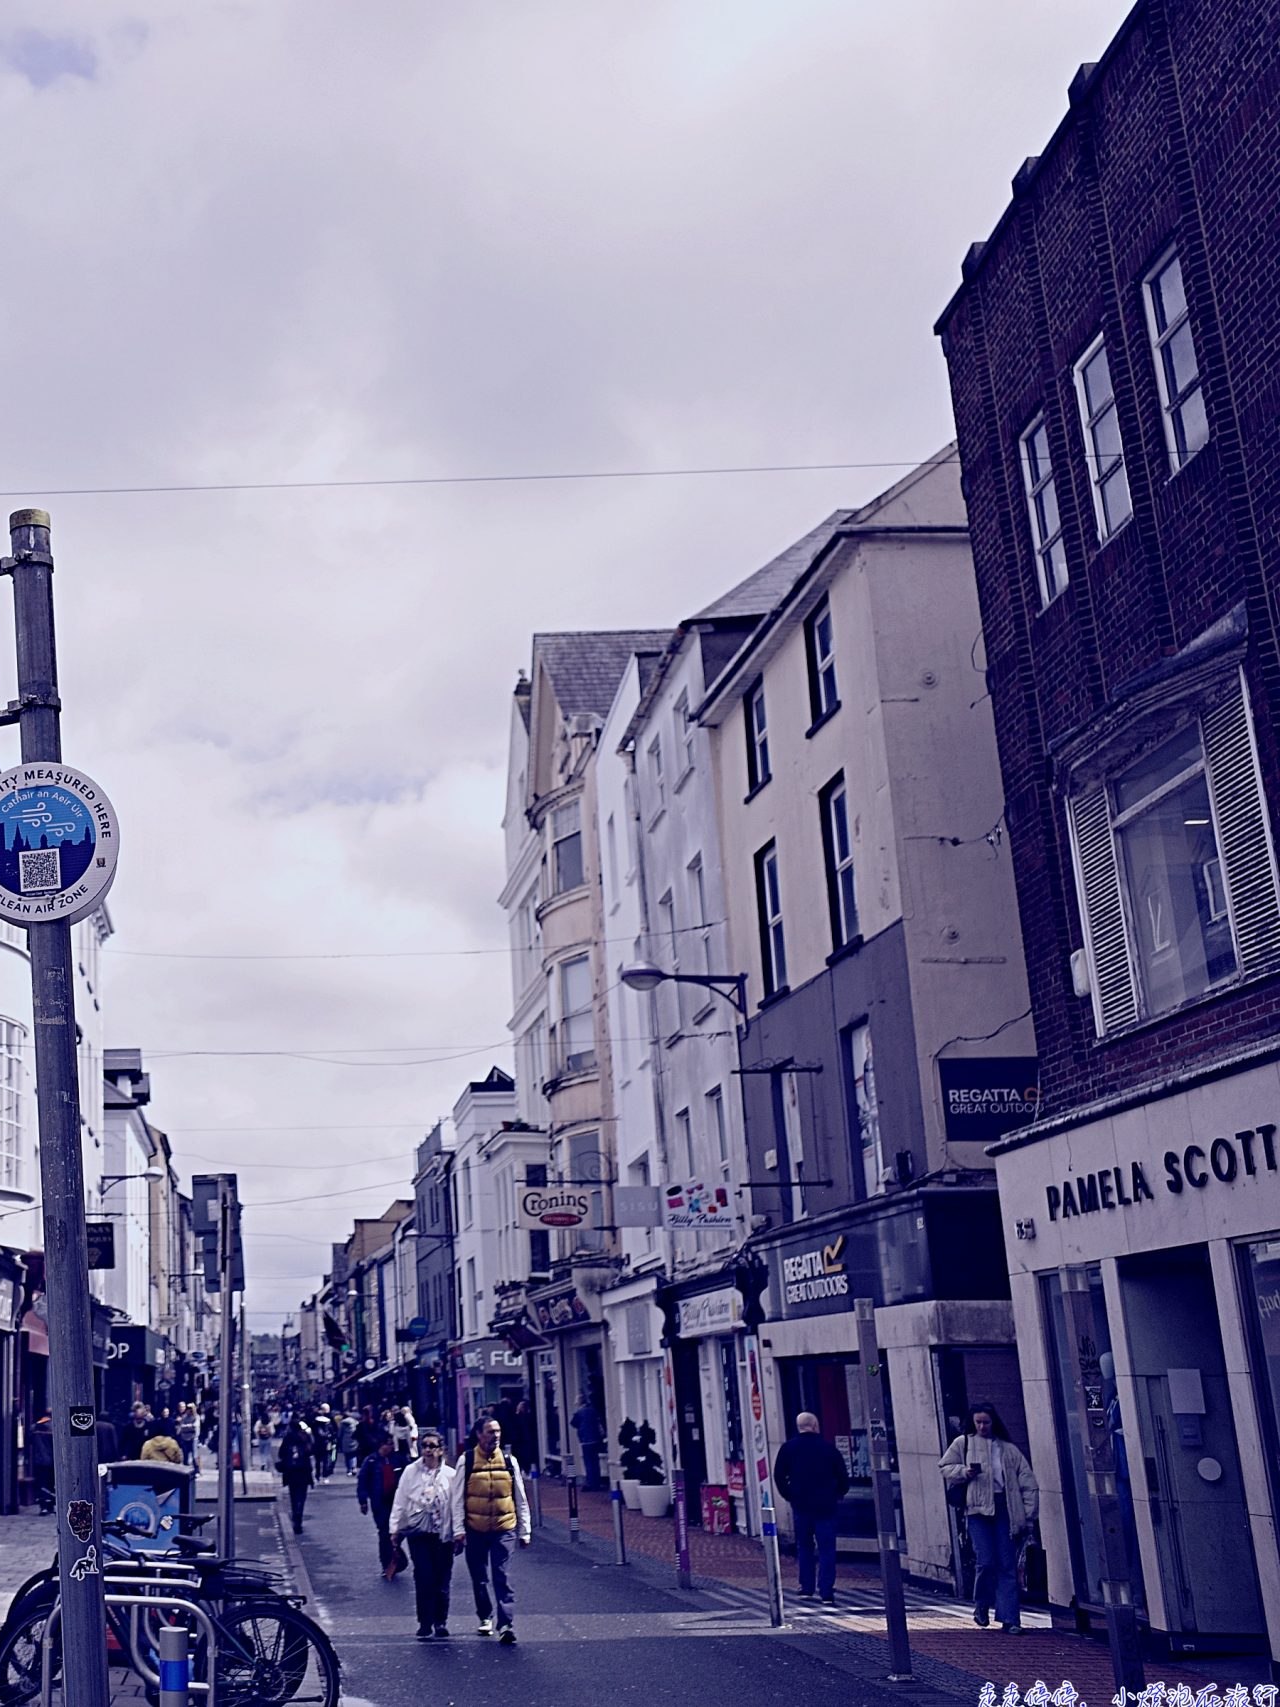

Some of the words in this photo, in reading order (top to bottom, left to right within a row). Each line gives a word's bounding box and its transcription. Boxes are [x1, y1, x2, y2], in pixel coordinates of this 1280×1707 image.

[1, 790, 34, 813] Cathair
[37, 791, 49, 799] an
[51, 792, 72, 807] Aeir
[24, 769, 95, 801] MEASURED
[93, 802, 111, 839] HERE
[35, 902, 56, 914] AIR
[59, 884, 89, 909] ZONE
[948, 1088, 1021, 1103] REGATTA
[950, 1103, 987, 1115] GREAT
[1046, 1161, 1154, 1222] PAMELA
[1164, 1123, 1278, 1193] SCOTT
[522, 1192, 589, 1217] Cronins
[784, 1250, 824, 1283] REGATTA
[786, 1282, 807, 1304] GREAT
[807, 1274, 848, 1300] OUTDOORS
